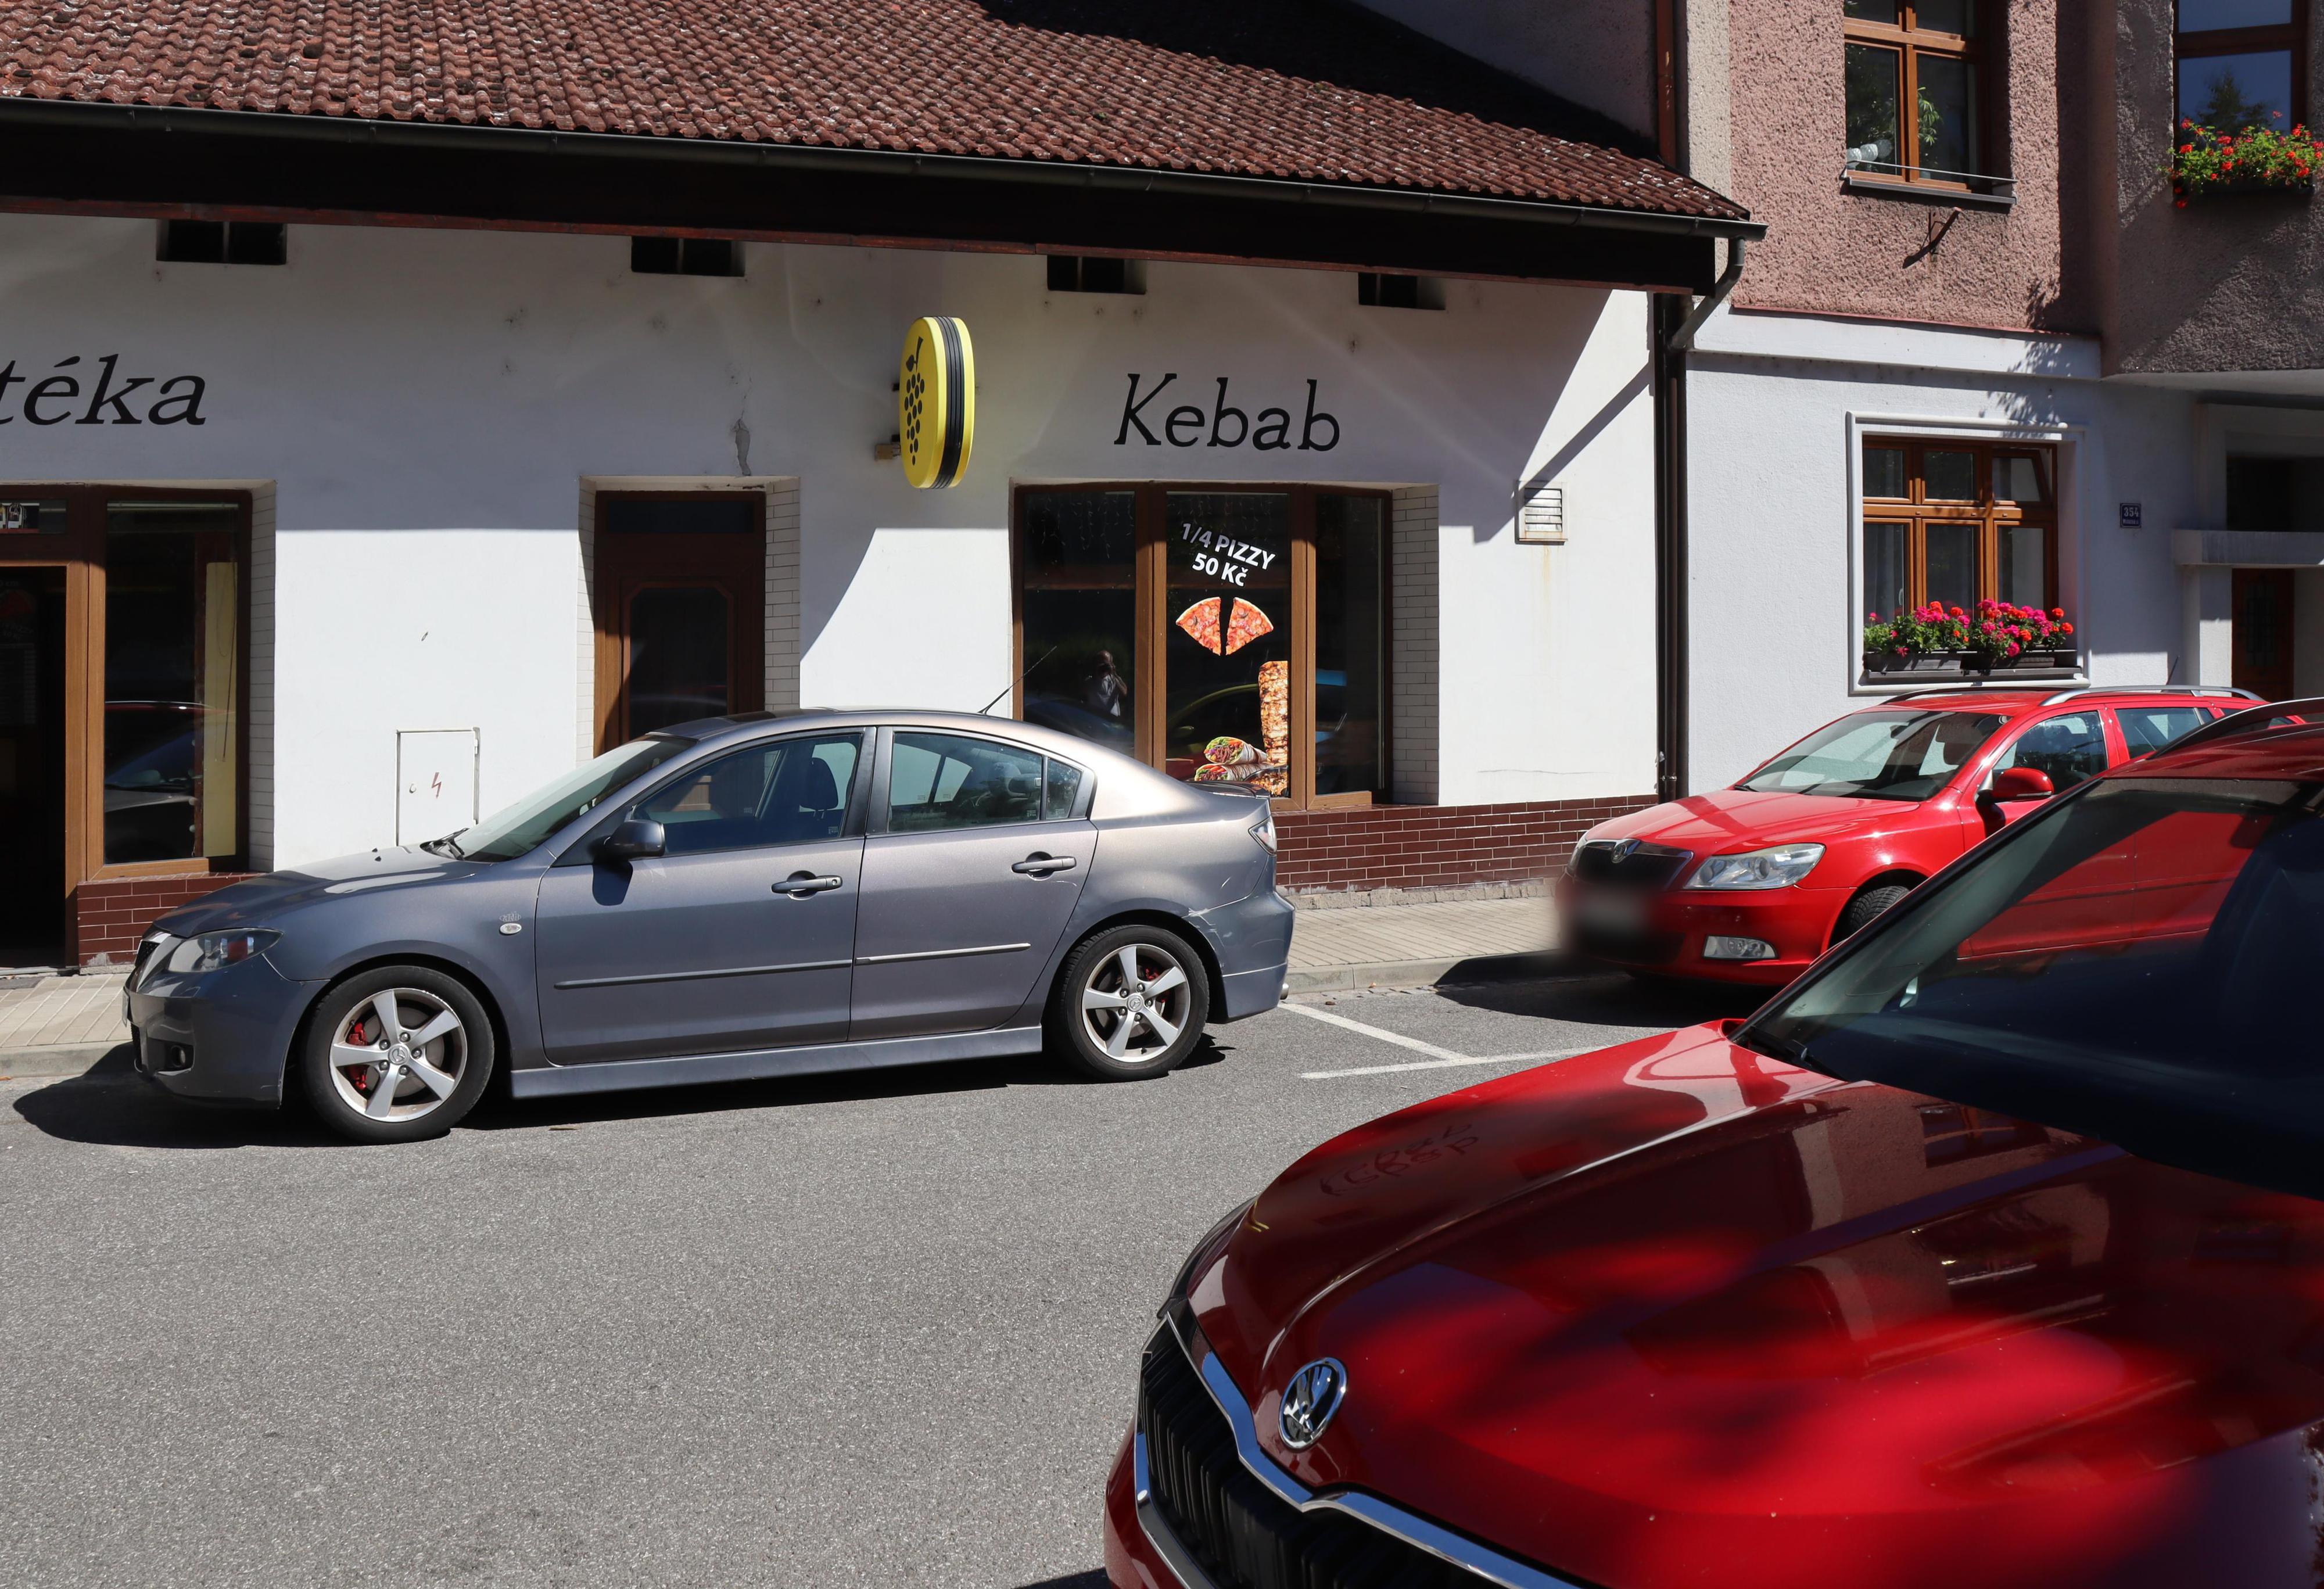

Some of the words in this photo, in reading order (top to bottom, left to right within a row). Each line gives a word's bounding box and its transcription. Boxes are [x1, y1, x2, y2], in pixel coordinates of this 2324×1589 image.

[1114, 373, 1340, 451] Kebab
[2124, 507, 2139, 517] 354
[1182, 523, 1213, 548] 1/4
[1215, 535, 1276, 570] PIZZY
[1192, 553, 1219, 576] 50
[1221, 562, 1249, 587] Kč
